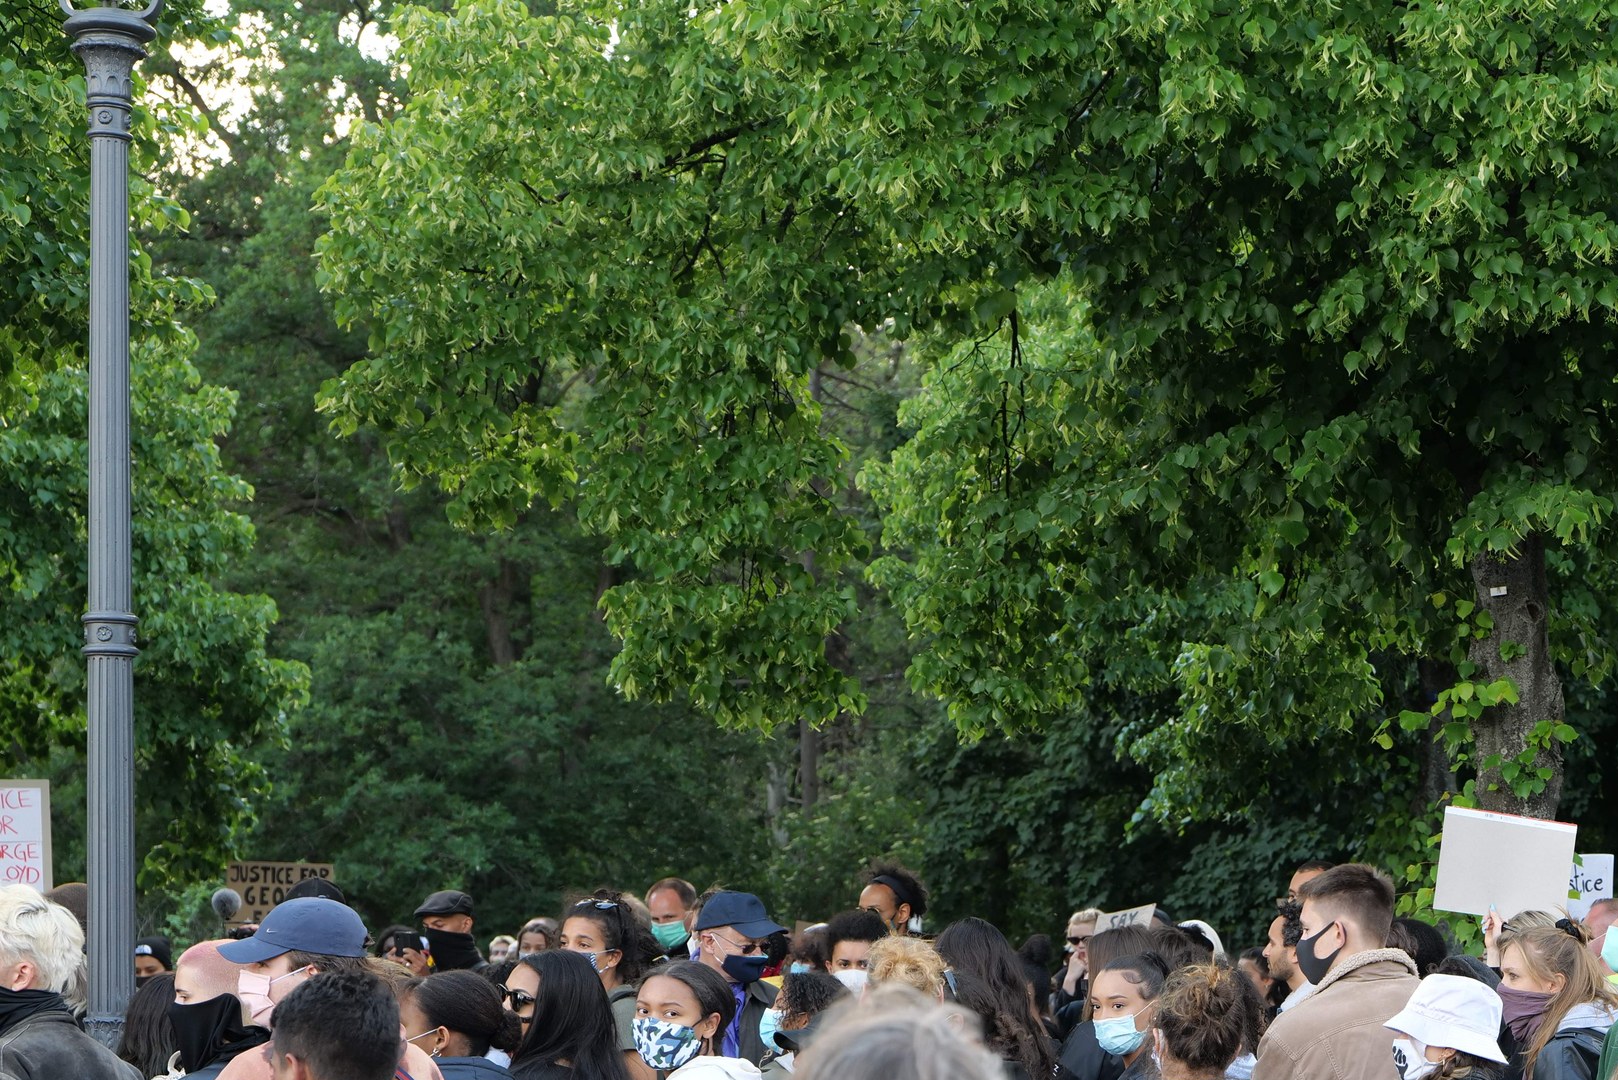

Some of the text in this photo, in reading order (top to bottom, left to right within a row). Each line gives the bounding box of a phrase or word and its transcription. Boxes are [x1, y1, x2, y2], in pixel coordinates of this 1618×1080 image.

[0, 789, 33, 809] ICE
[0, 842, 40, 863] RGE
[230, 865, 294, 885] JUSTICE
